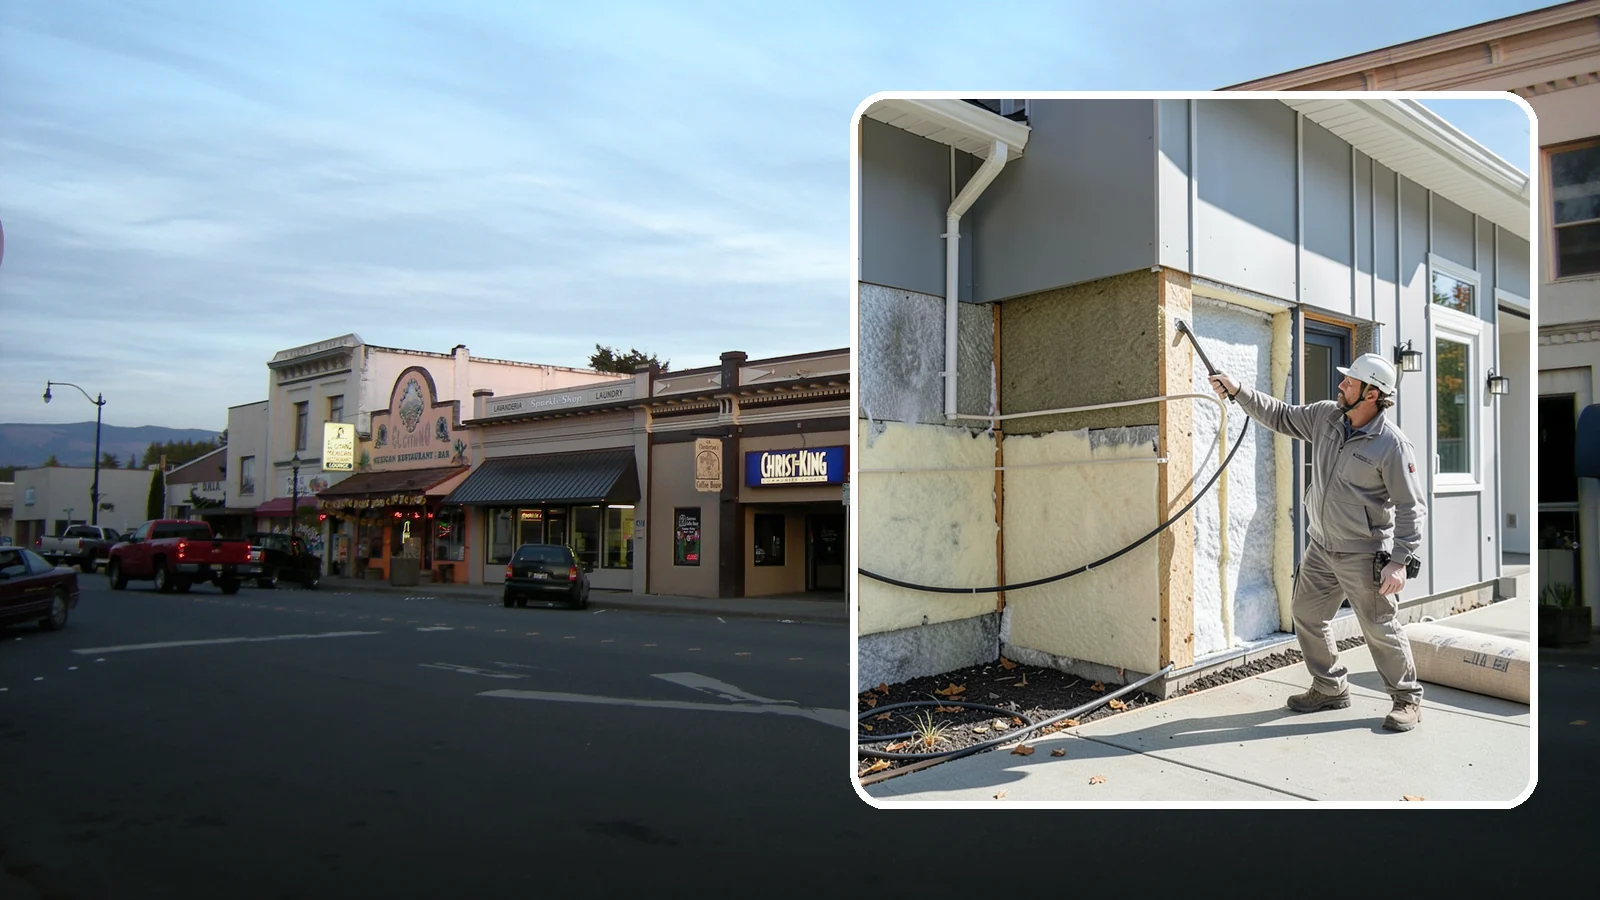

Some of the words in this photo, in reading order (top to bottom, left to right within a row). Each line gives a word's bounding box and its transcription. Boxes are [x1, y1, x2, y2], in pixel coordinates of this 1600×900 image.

[493, 402, 523, 412] LAVANDERIA
[561, 394, 583, 405] Shop
[595, 389, 624, 400] LAUNDRY
[373, 455, 396, 464] MEXICAN
[397, 451, 434, 462] RESTAURANT
[437, 450, 450, 459] BAR
[761, 452, 797, 478] CHRIST
[799, 450, 827, 476] KING
